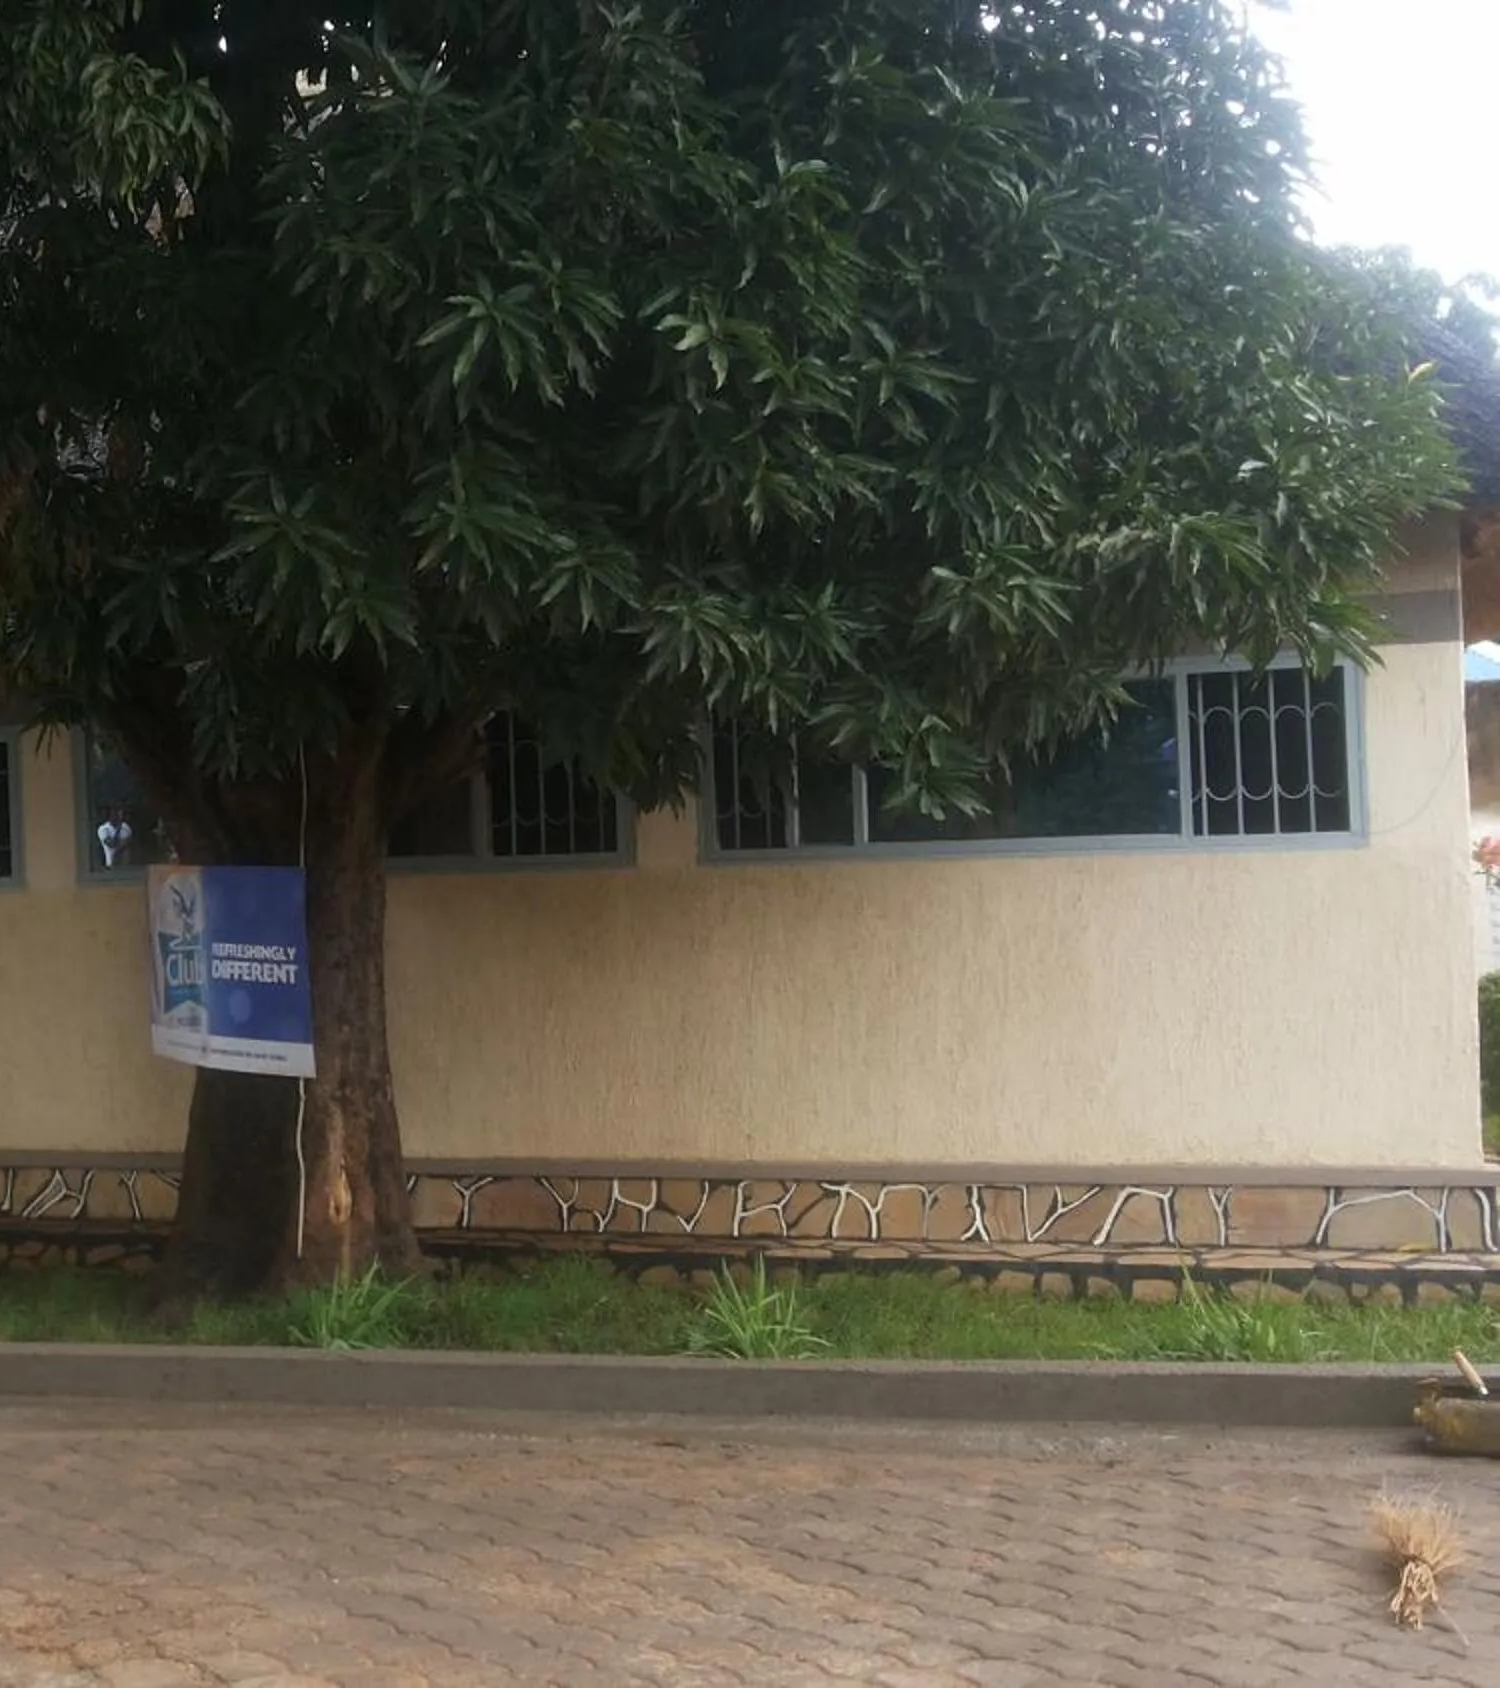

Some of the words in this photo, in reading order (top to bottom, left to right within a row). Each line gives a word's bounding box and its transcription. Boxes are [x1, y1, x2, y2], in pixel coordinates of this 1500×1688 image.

[212, 943, 296, 961] REFRESHINGLY
[166, 953, 205, 987] Club
[212, 960, 298, 985] DIFFERENT
